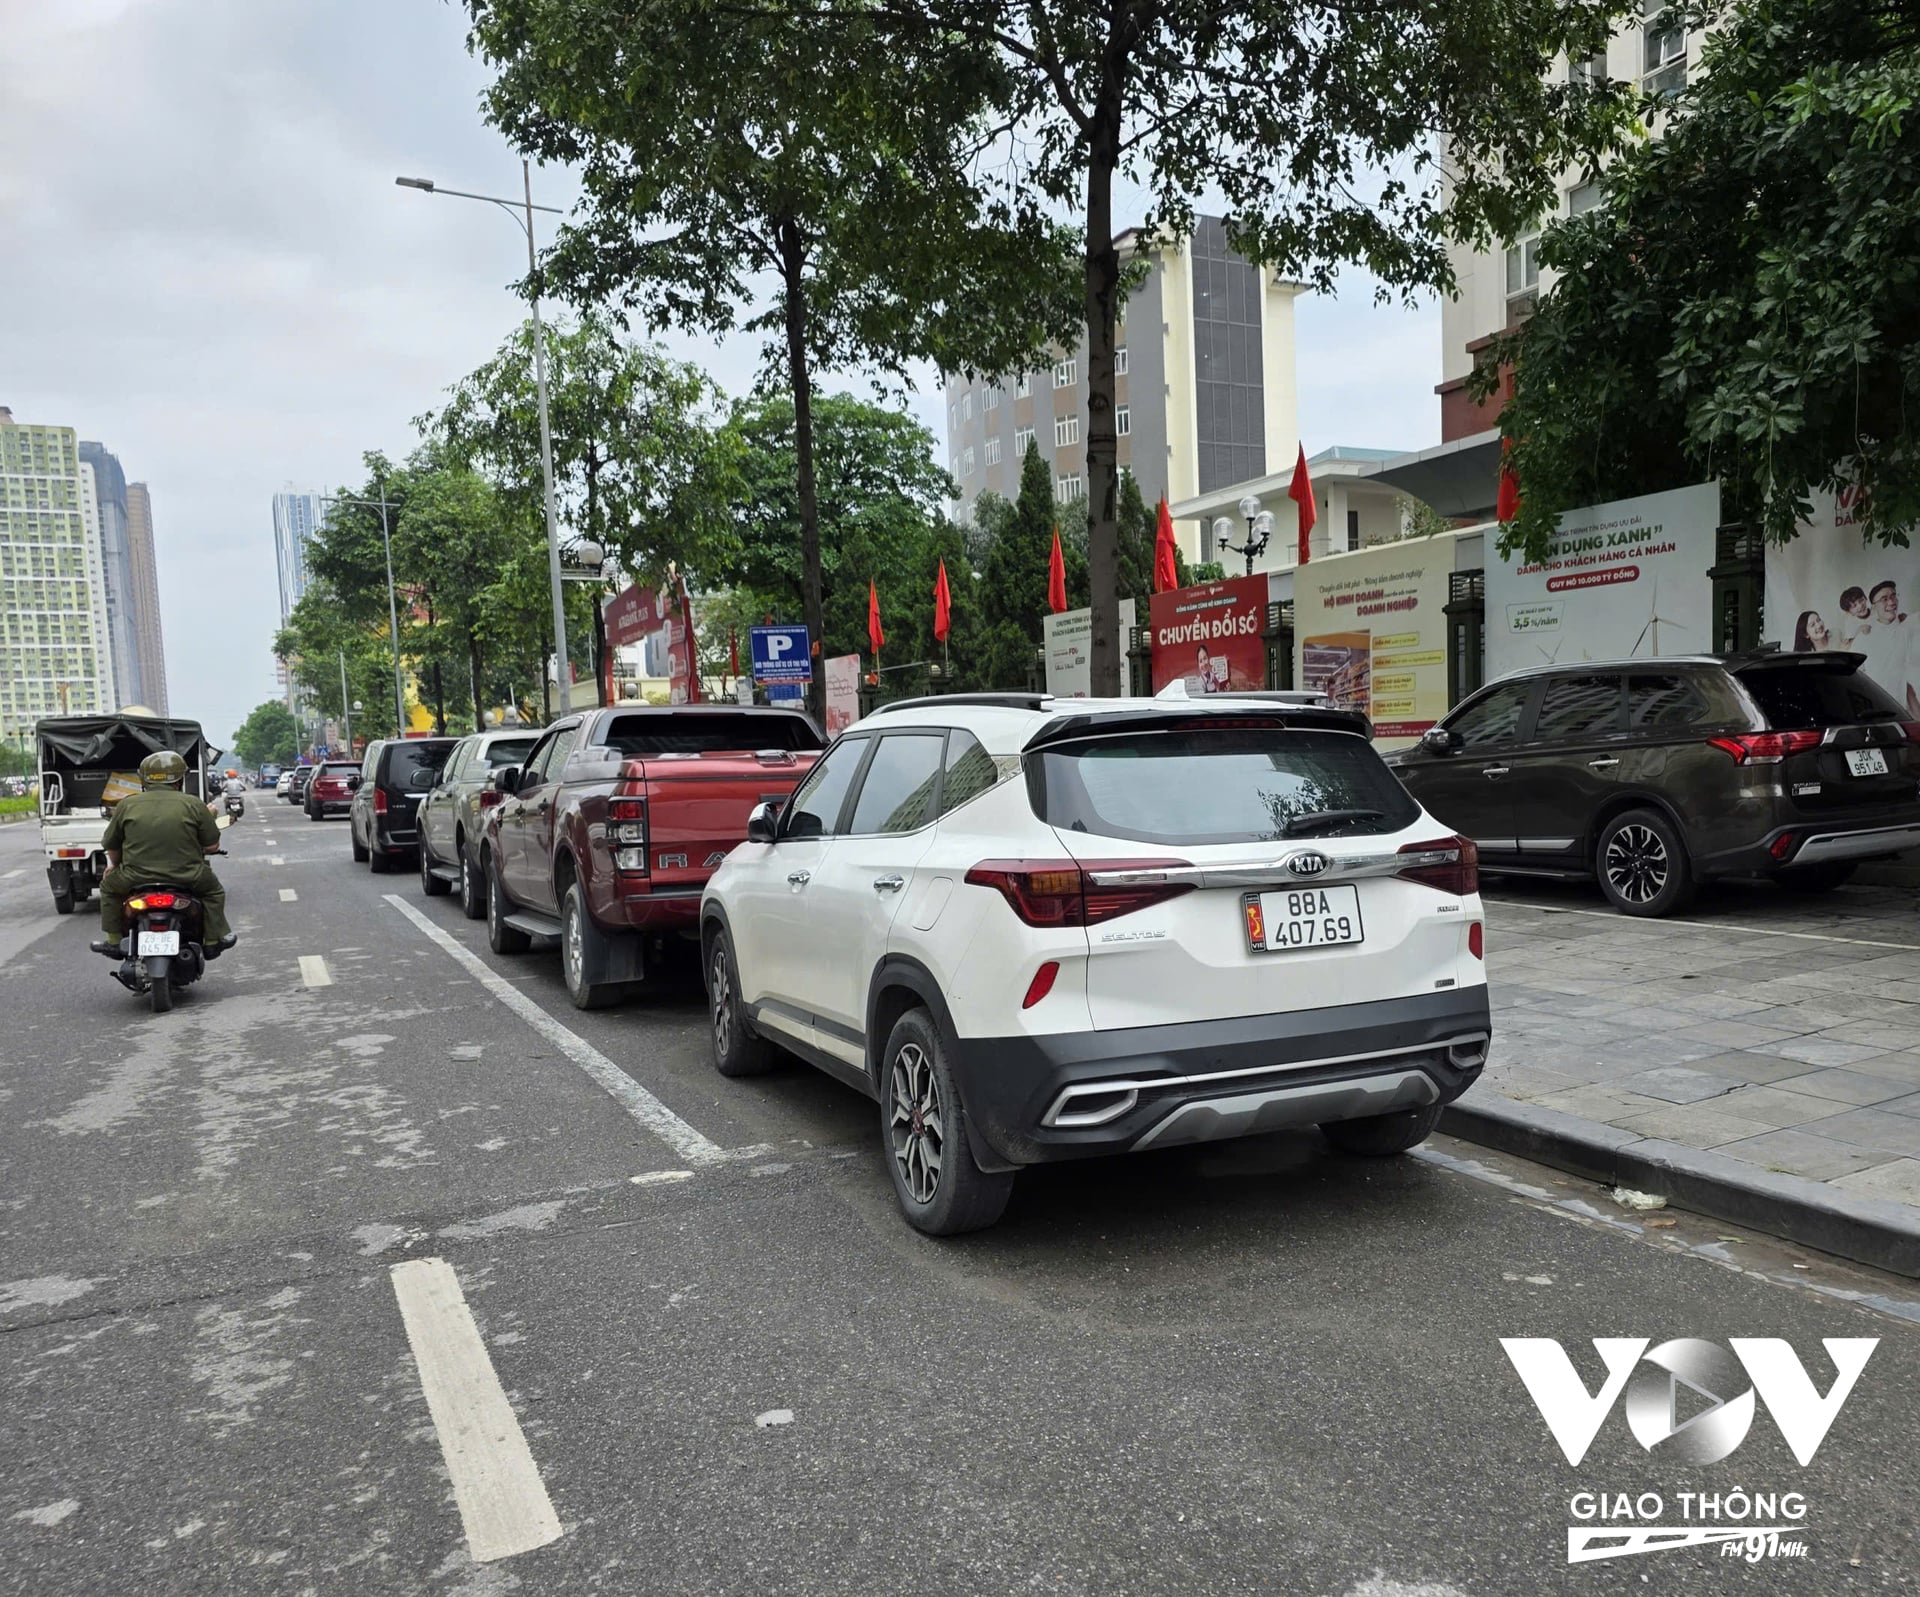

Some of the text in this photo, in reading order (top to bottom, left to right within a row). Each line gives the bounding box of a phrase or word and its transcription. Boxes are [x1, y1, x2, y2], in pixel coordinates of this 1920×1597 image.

[1561, 536, 1604, 557] DỤNG
[1607, 526, 1651, 547] XANH
[1517, 542, 1676, 576] DÀNH CHO KHÁCH HÀNG CÁ NHÂN
[1550, 580, 1564, 589] QUY
[1578, 575, 1601, 585] 10.000
[1613, 568, 1635, 580] ĐỒNG
[1323, 588, 1384, 610] HỘ KINH DOANH
[1357, 595, 1418, 617] DOANH NGHIỆP
[1159, 606, 1258, 646] CHUYỂN ĐỔI SỐ
[1513, 616, 1531, 631] 3,5
[767, 635, 793, 660] P
[1856, 750, 1874, 762] 30K
[1294, 855, 1324, 872] KIA
[1288, 890, 1331, 917] 88A
[1101, 930, 1166, 942] SELTOS
[1275, 916, 1352, 946] 407.69
[1252, 942, 1265, 950] VIE
